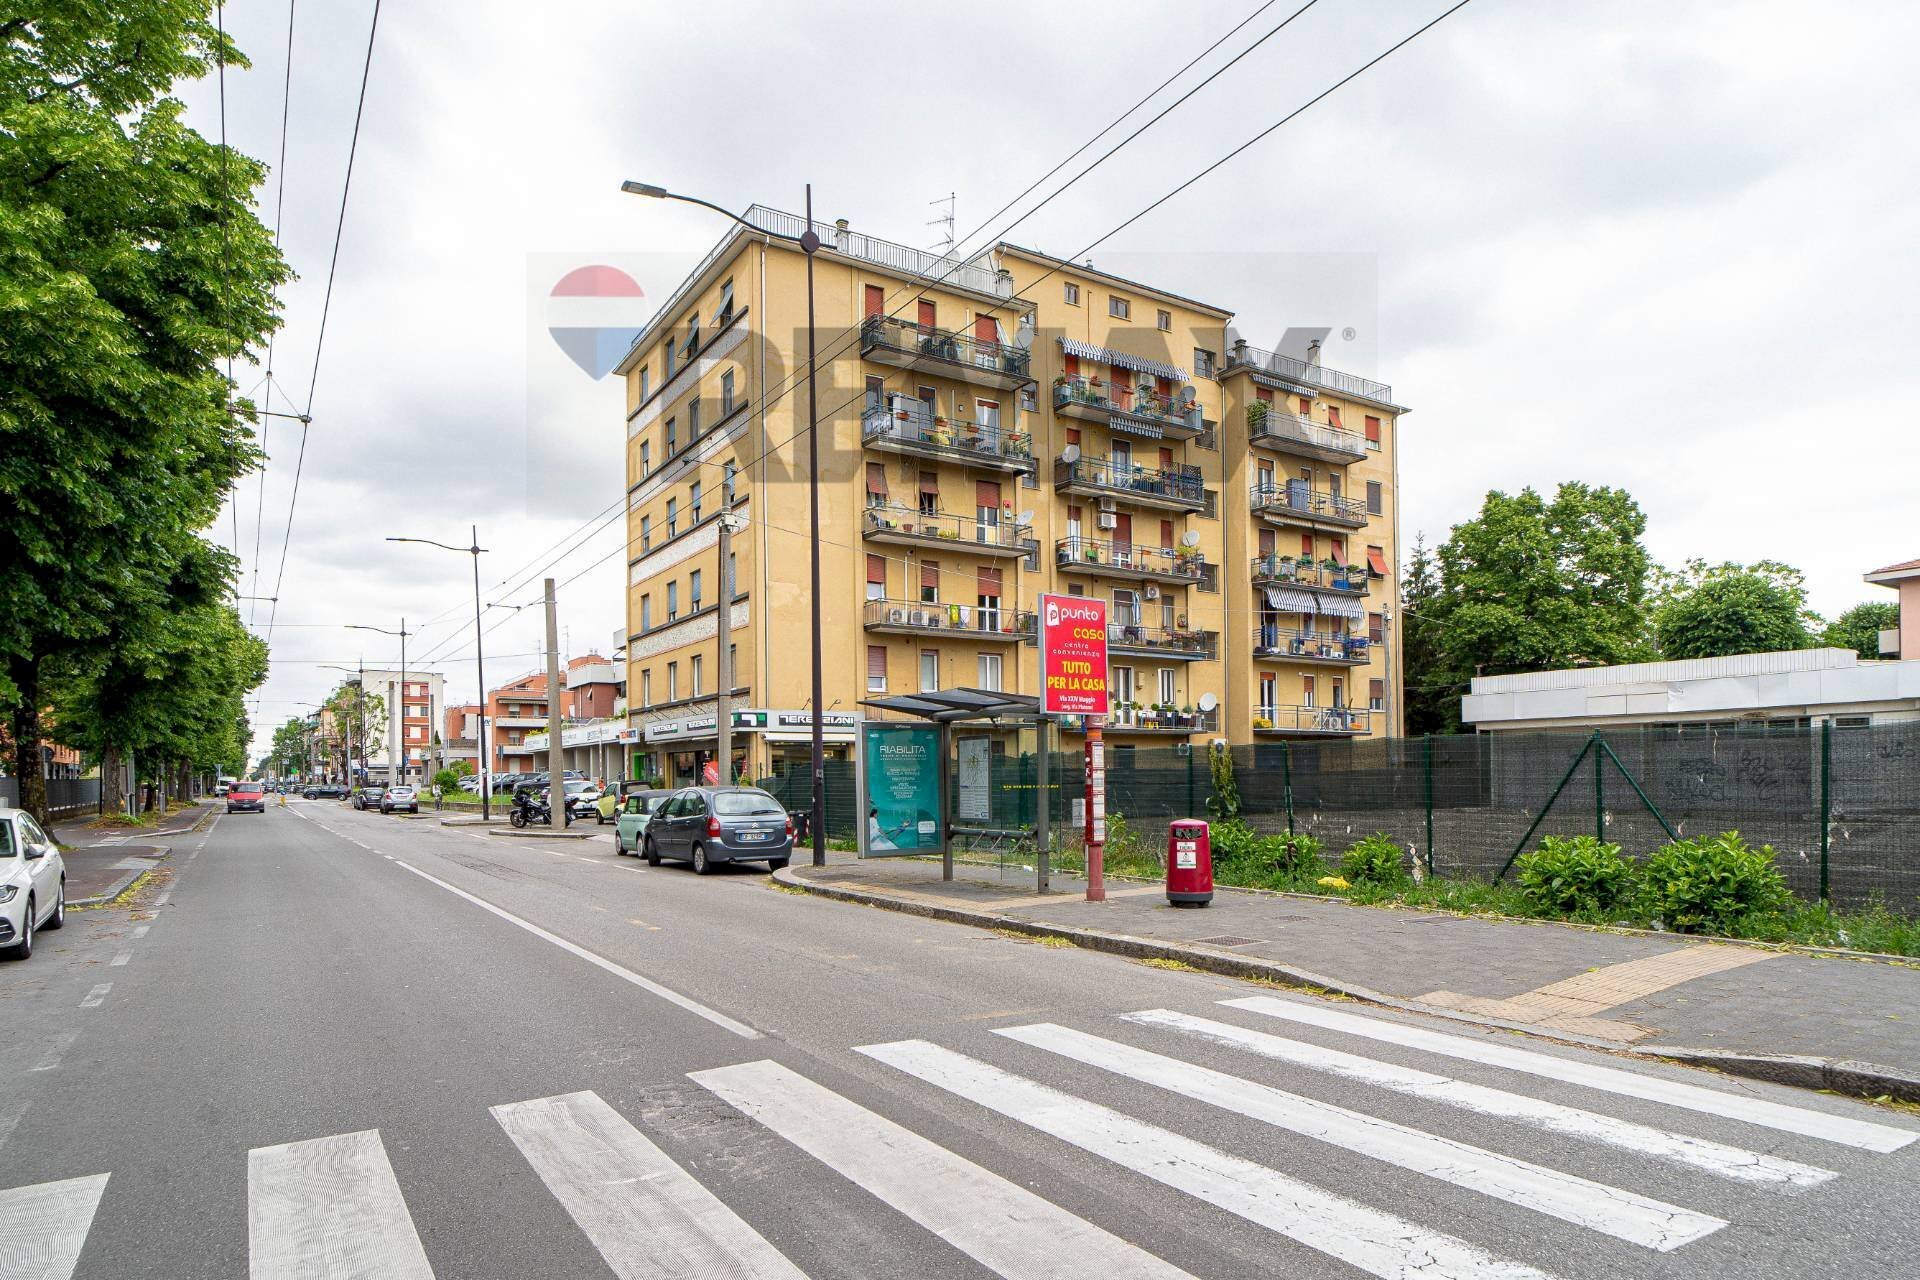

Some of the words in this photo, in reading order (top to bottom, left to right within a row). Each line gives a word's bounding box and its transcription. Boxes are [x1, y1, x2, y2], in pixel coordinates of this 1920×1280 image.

[1061, 606, 1098, 621] punto
[1073, 627, 1104, 640] casa
[1062, 661, 1090, 674] TUTTO
[1047, 676, 1066, 689] PER
[1069, 677, 1080, 690] LA
[1082, 678, 1105, 690] CASA
[779, 715, 854, 724] TEREZIANI
[880, 745, 926, 754] RIABILITA
